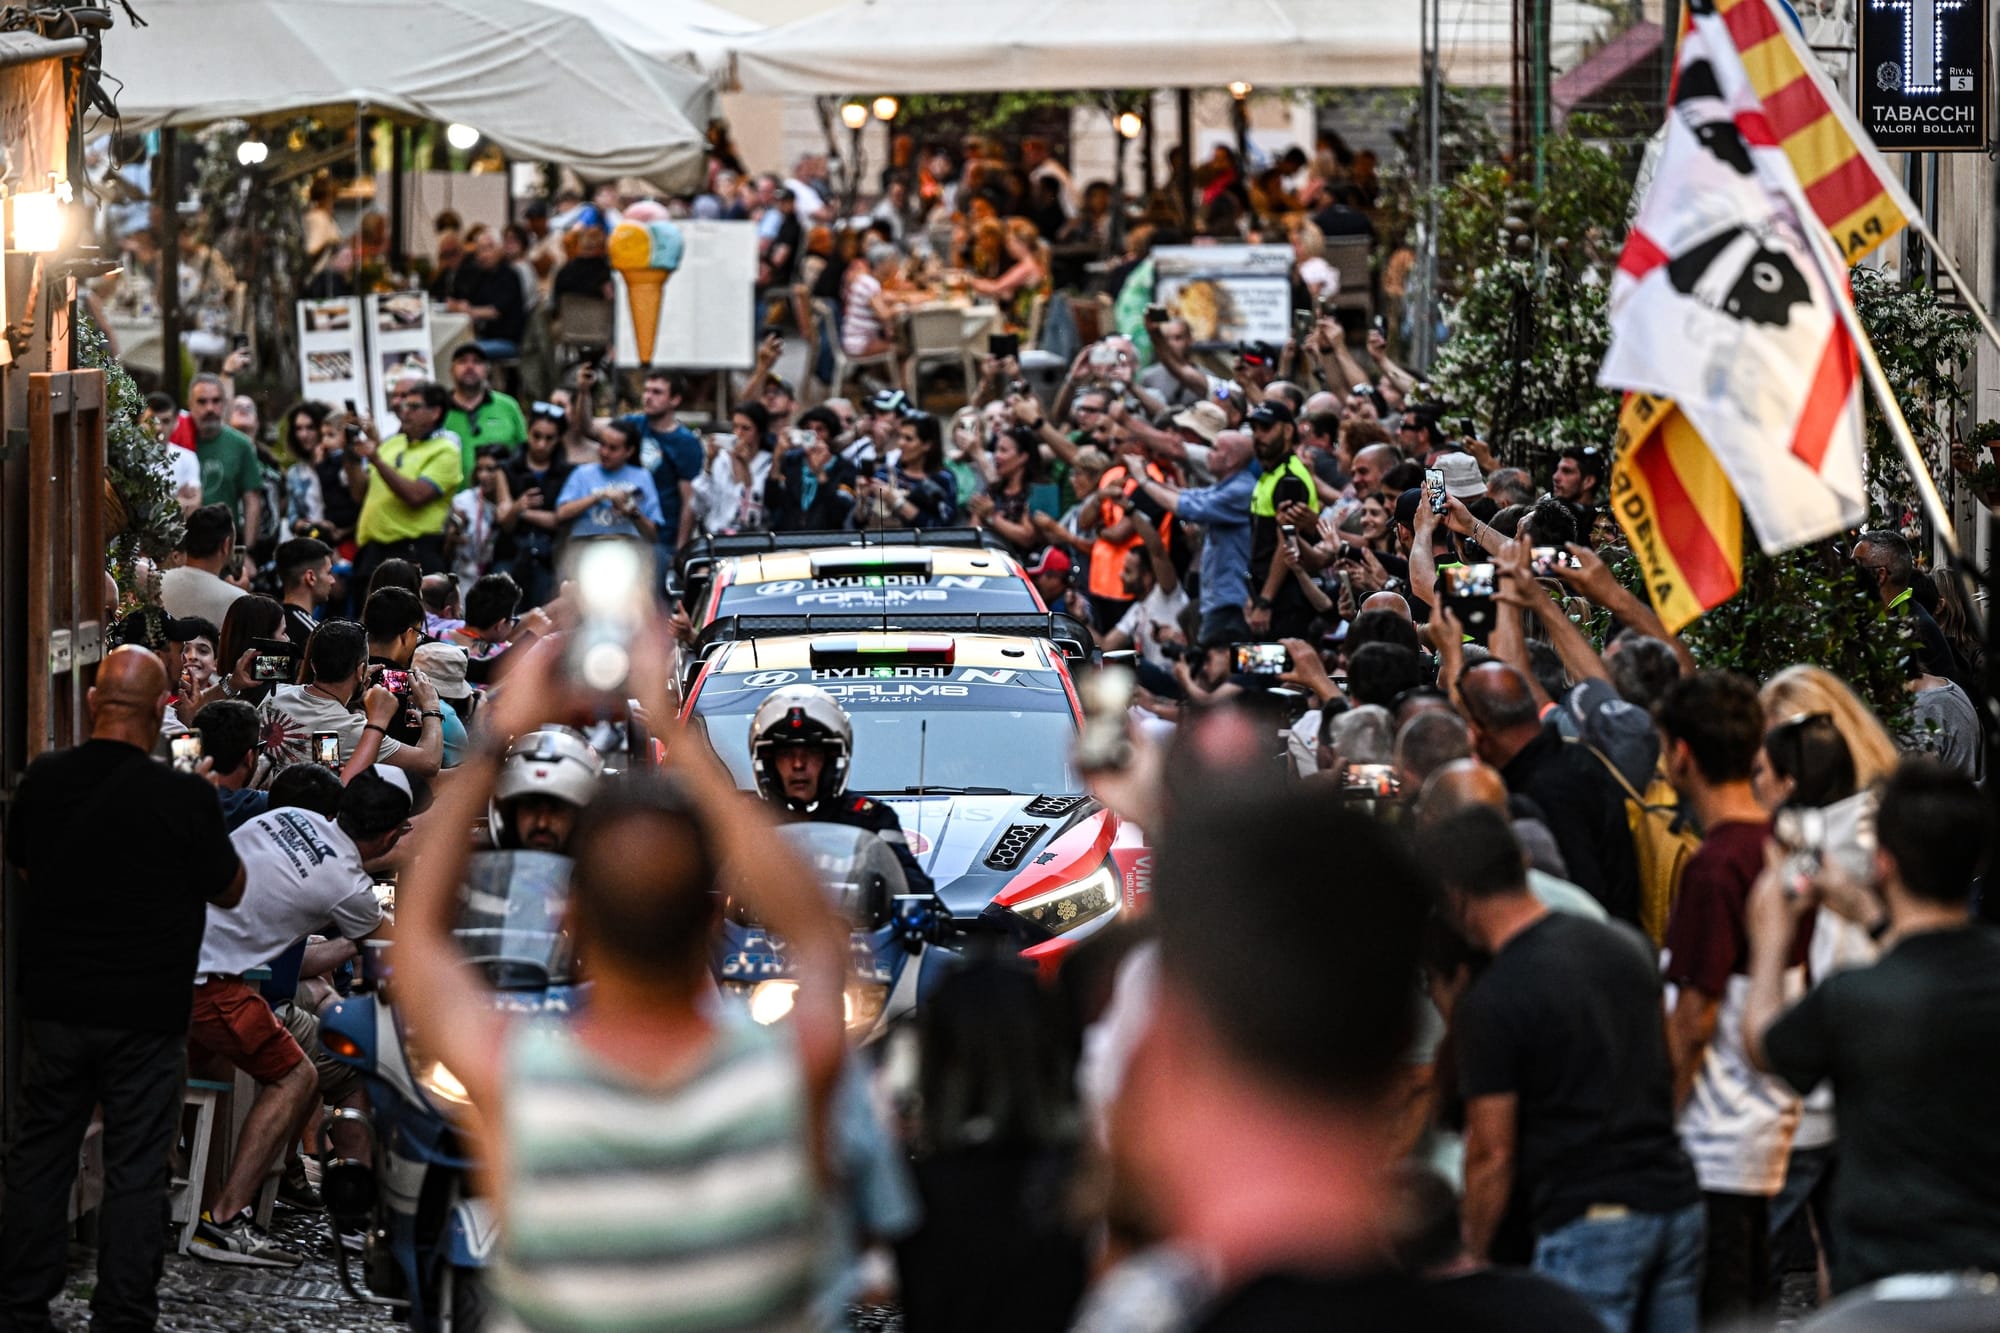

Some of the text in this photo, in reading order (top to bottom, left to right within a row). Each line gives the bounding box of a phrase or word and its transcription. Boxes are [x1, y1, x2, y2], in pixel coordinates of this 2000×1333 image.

[1957, 78, 1966, 90] 5
[1872, 105, 1975, 121] TABACCHI
[1873, 124, 1975, 133] VALORI BOLLATI
[796, 590, 948, 605] FORUM8
[819, 685, 968, 696] ORUM8
